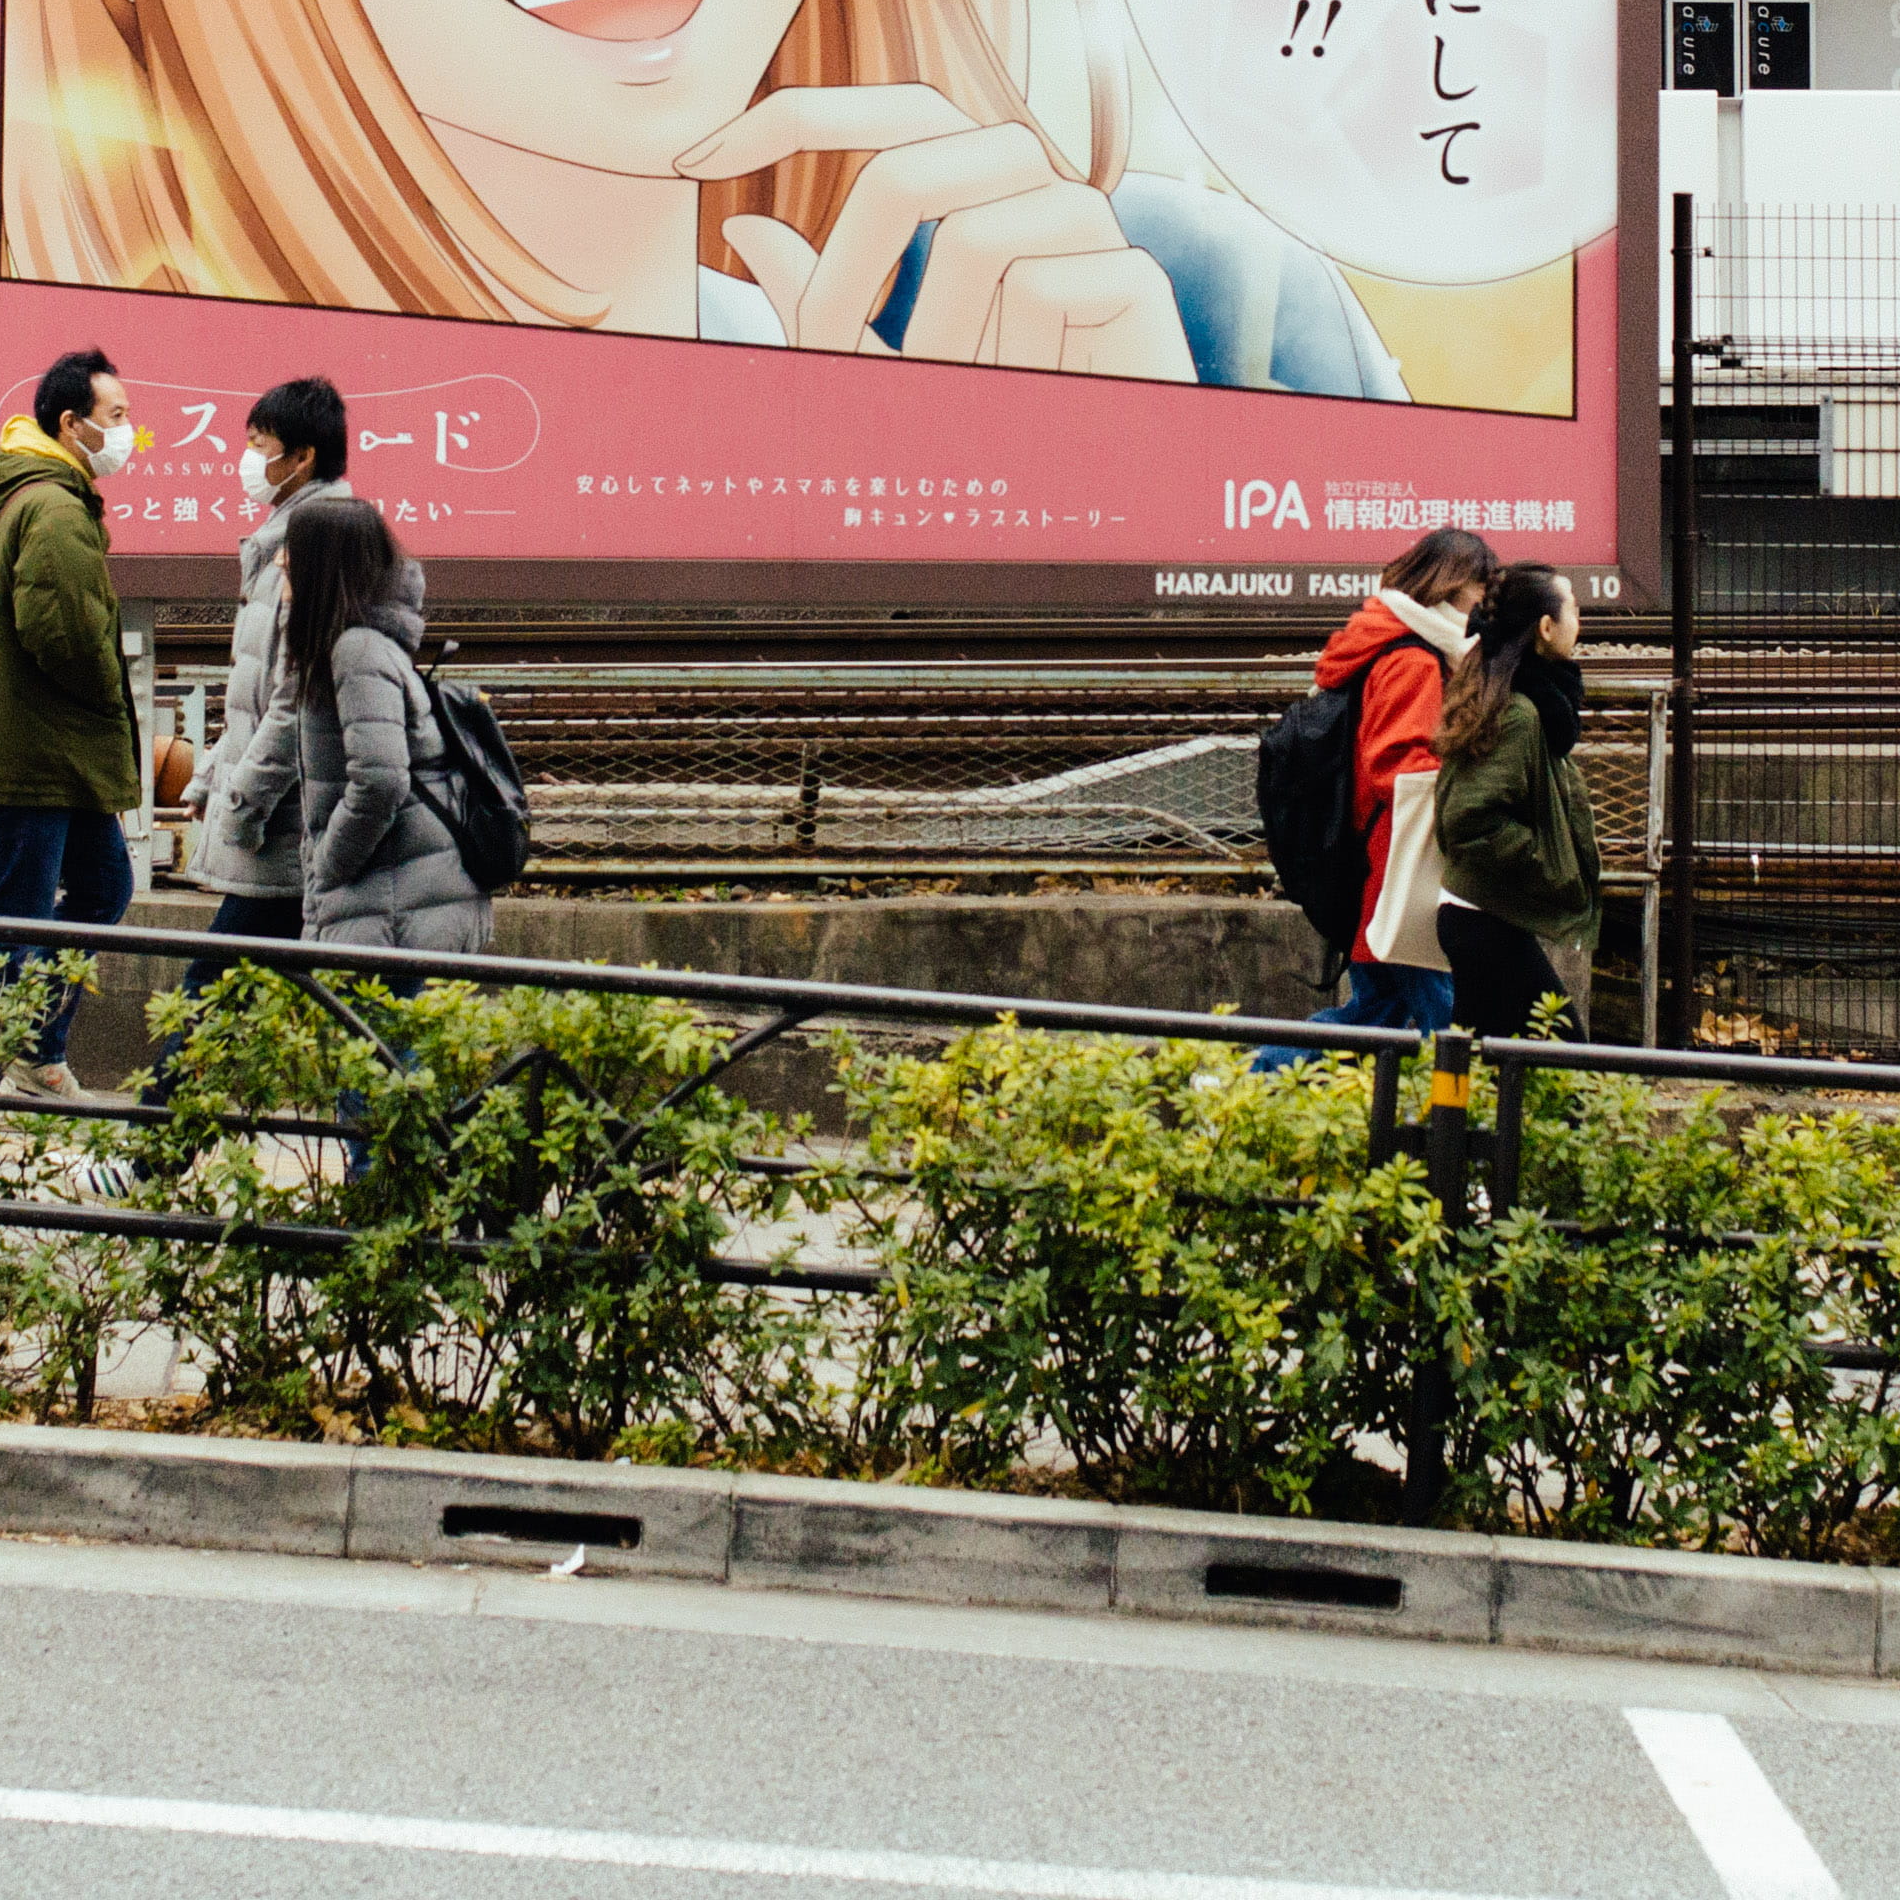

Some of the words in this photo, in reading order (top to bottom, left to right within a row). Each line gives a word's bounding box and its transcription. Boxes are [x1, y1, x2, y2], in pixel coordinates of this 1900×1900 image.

[1682, 5, 1696, 76] acure
[1757, 5, 1771, 76] acure
[126, 462, 236, 476] PASSWO
[576, 474, 1008, 497] 安心してネットやスマホを楽しむための
[1324, 480, 1419, 499] 独立行政法人
[1223, 478, 1311, 531] IPA
[1323, 499, 1577, 533] 情報処理推進機構
[1155, 572, 1294, 597] HARAJUKU
[1308, 573, 1381, 597] FASHI
[1589, 575, 1620, 599] 10
